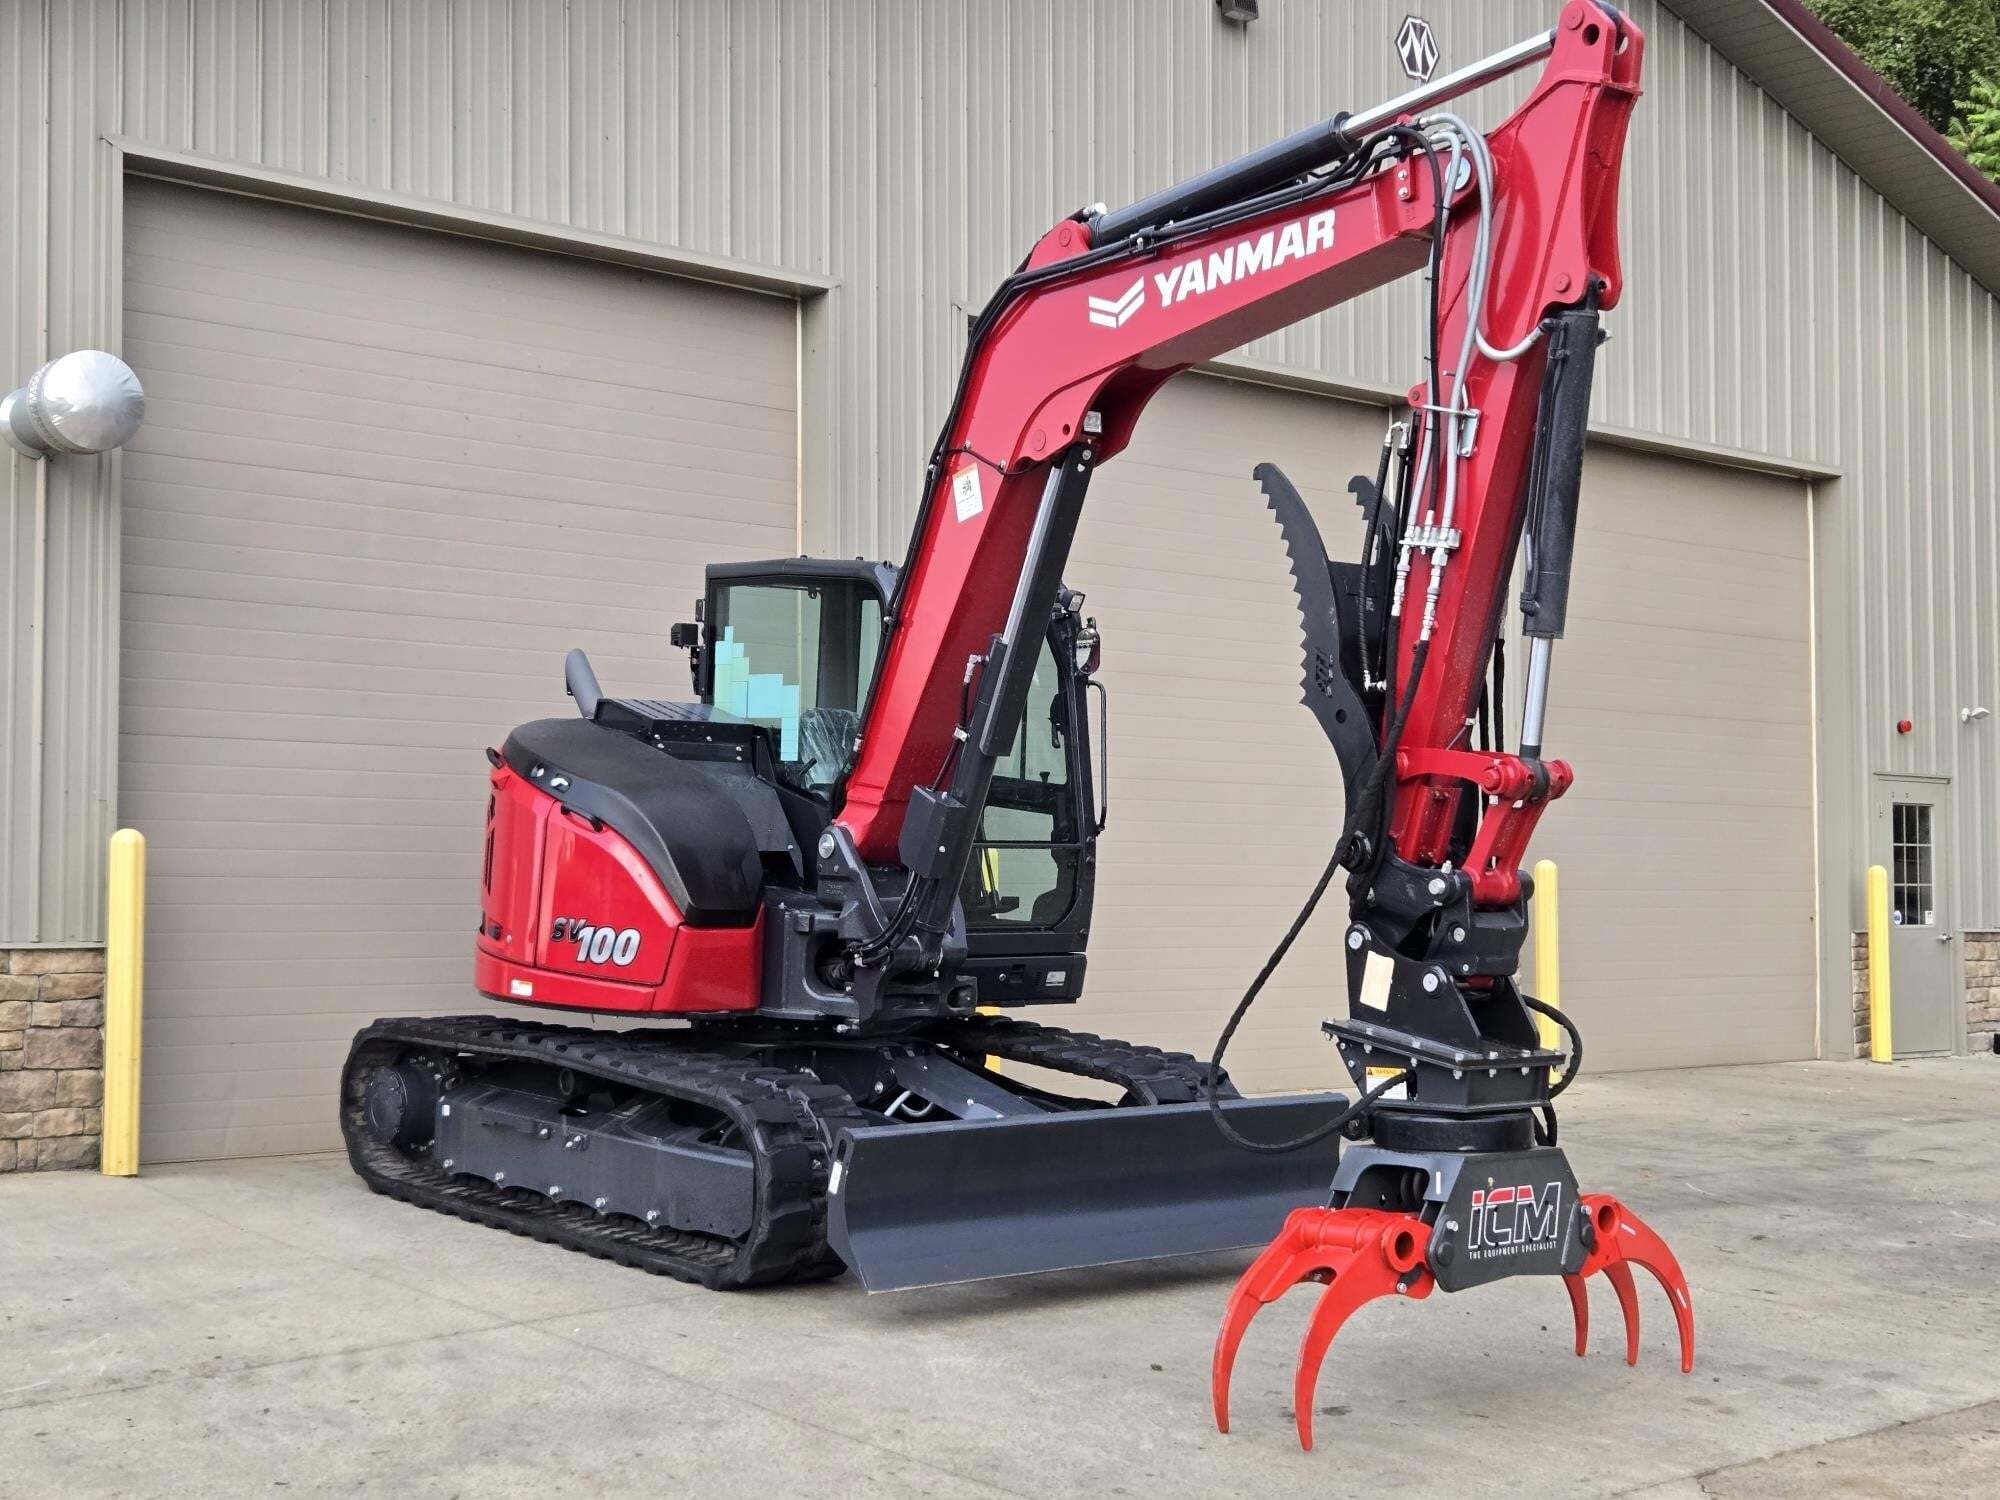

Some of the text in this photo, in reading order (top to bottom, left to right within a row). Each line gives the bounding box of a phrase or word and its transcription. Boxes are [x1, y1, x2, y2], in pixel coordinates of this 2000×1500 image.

[1154, 209, 1336, 308] YANMAR
[1469, 1241, 1556, 1260] THE EQUIPMENT SPECIALIST
